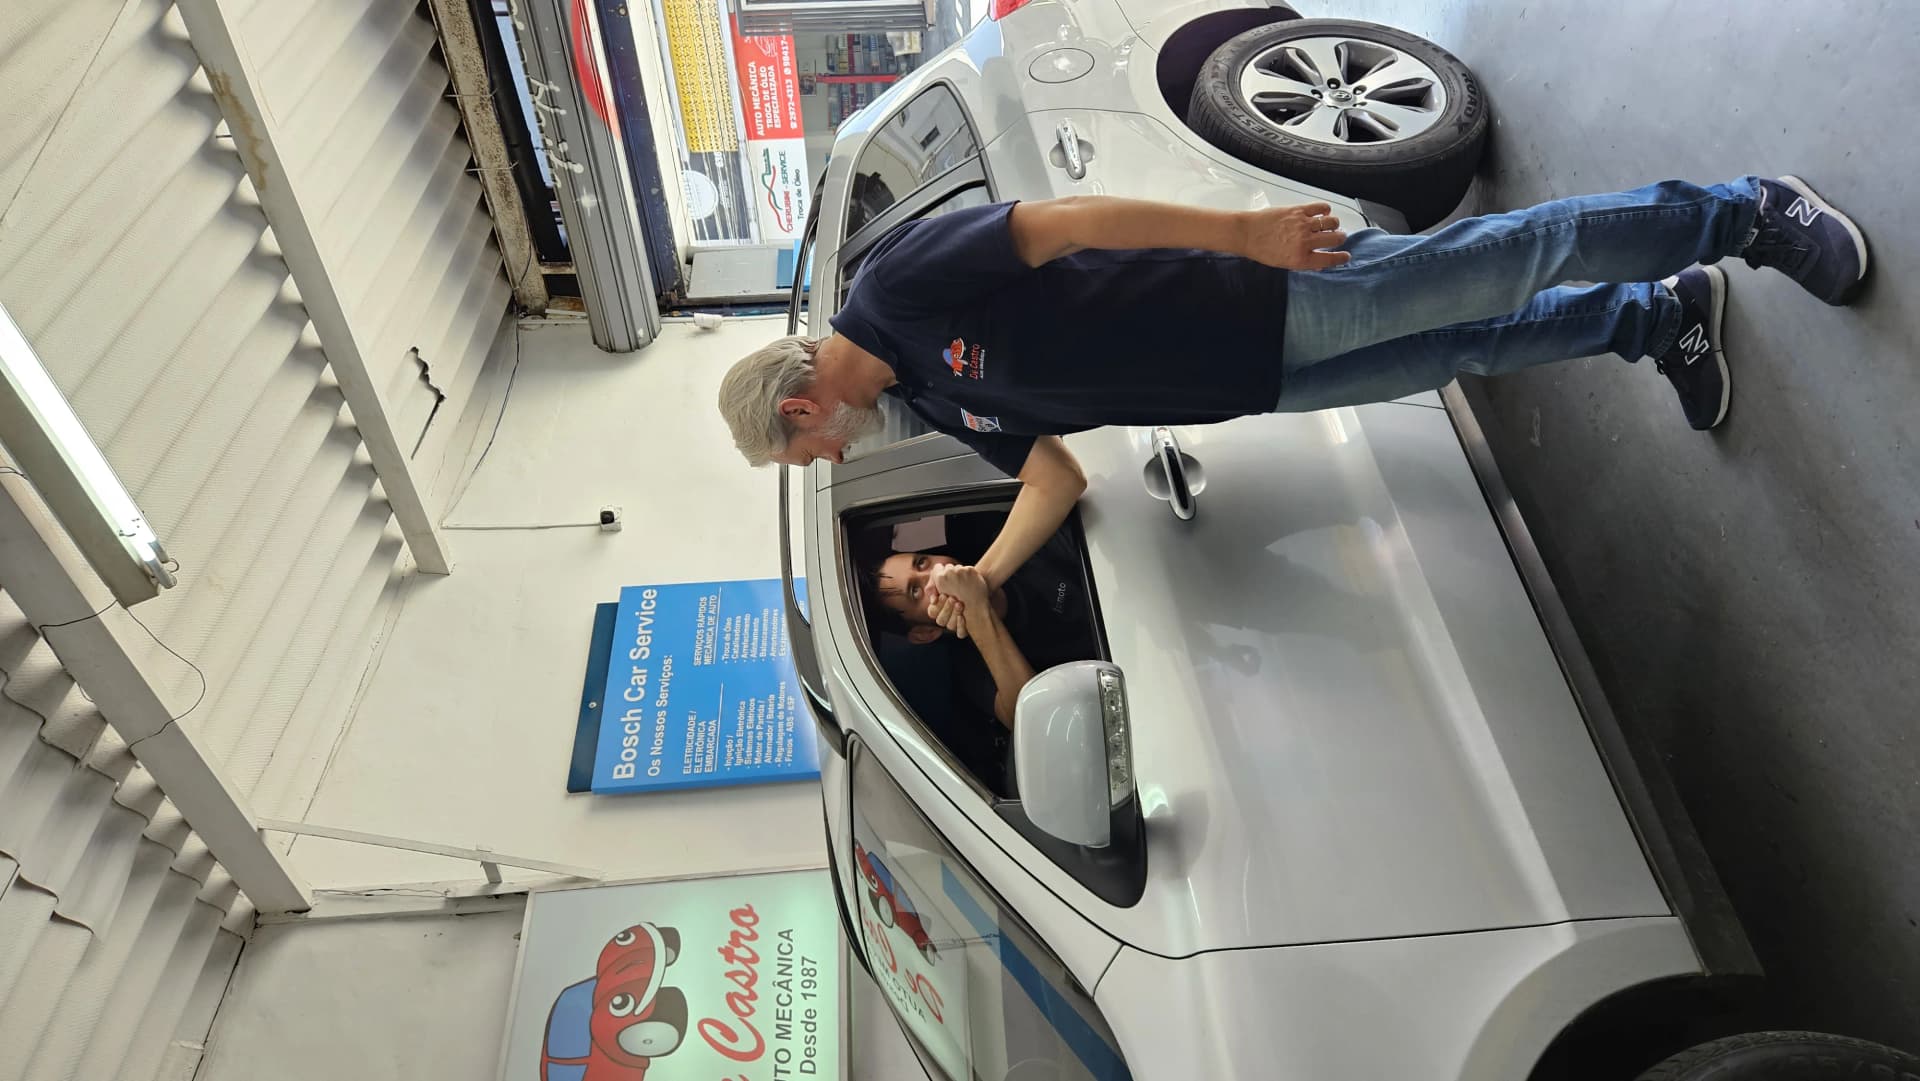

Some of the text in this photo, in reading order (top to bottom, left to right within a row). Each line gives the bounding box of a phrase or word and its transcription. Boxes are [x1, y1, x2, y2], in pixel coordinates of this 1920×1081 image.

[748, 61, 765, 136] AUTO MECÂNICA
[760, 66, 774, 128] TROCA DE ÓLEO
[769, 65, 781, 128] ESPECIALIZADA
[779, 151, 788, 184] SERVICE
[792, 169, 801, 186] Óleo
[796, 189, 802, 197] de
[694, 596, 707, 666] SERVIÇOS RÁPIDOS
[704, 594, 718, 664] MECÂNICA DE AUTO
[722, 618, 732, 660] Troca de Óleo
[612, 588, 657, 780] Bosch Car Service
[648, 654, 673, 776] Os Nossos Serviços:
[683, 715, 696, 774] ELETRICIDADE
[756, 732, 764, 740] de
[786, 716, 794, 732] ABS
[694, 721, 706, 773] ELETRÔNICA
[705, 720, 716, 772] EMBARCADA
[754, 742, 762, 764] Motor
[697, 904, 765, 1062] Castro
[772, 928, 793, 1040] MECÂNICA
[800, 956, 817, 1075] Desde 1987
